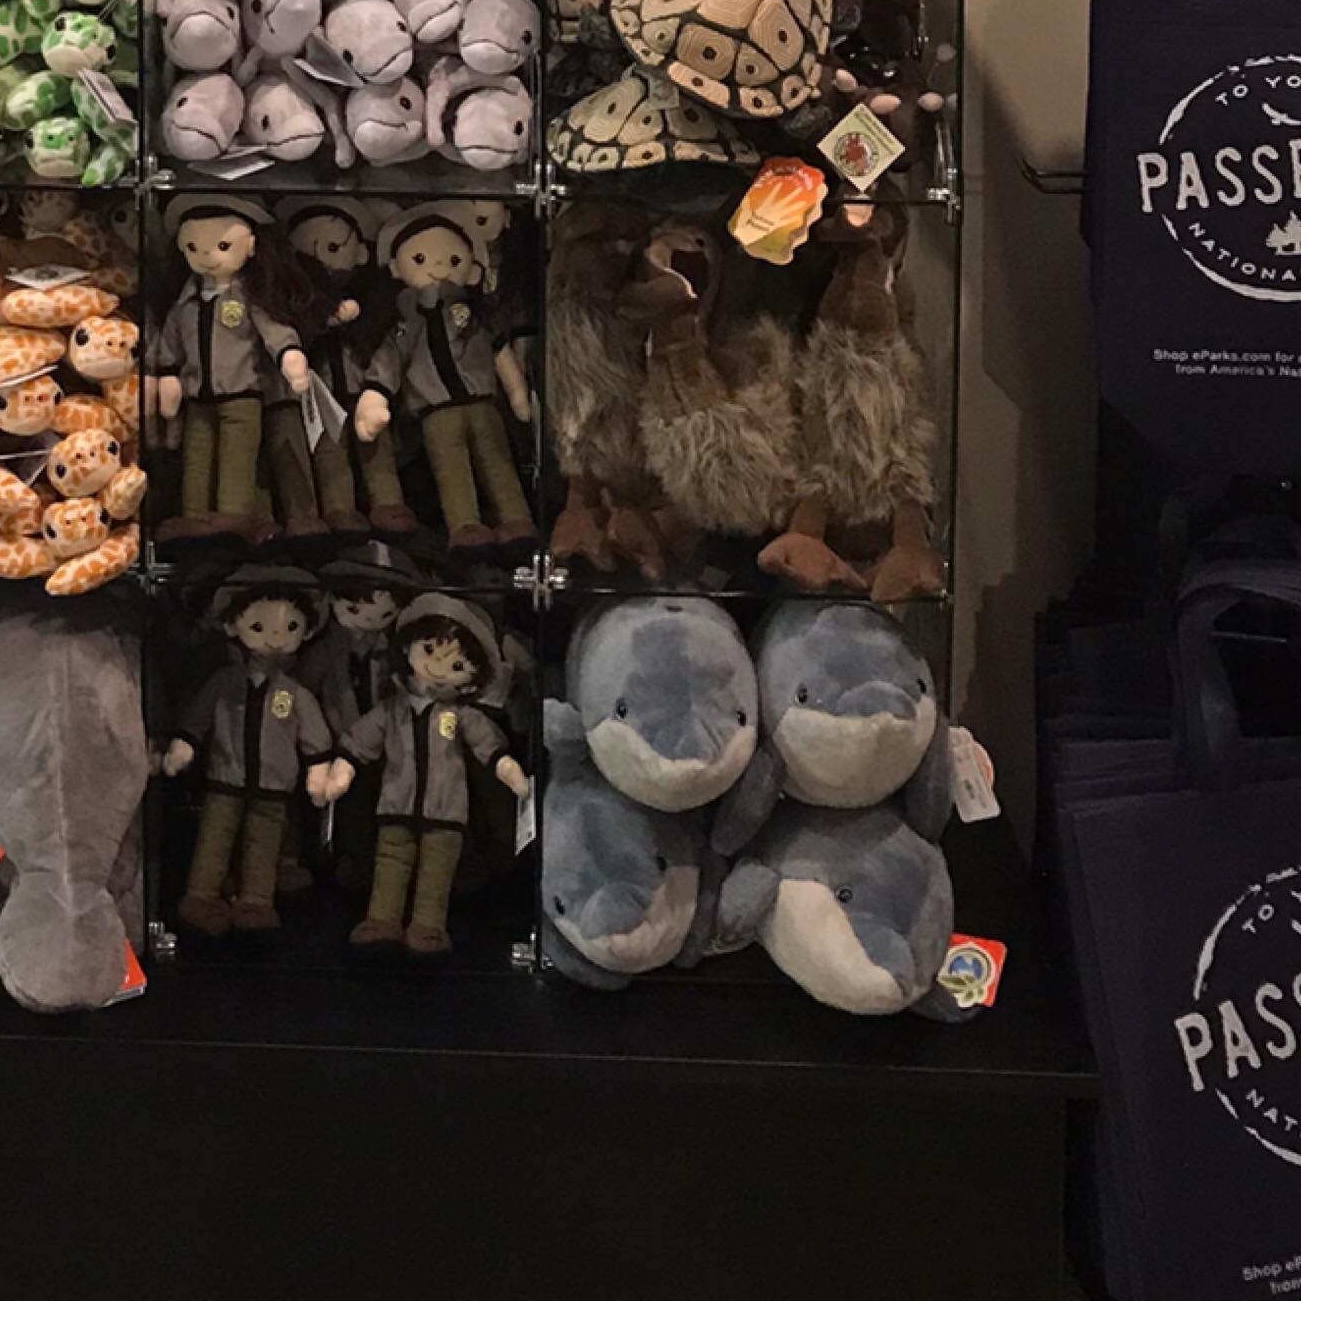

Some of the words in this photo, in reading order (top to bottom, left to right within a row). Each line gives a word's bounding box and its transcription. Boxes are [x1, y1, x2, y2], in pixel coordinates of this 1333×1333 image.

[1153, 349, 1189, 362] Shop
[1192, 350, 1270, 364] eParks.com
[1276, 351, 1294, 363] for
[1175, 363, 1208, 375] from
[1210, 364, 1276, 377] America's
